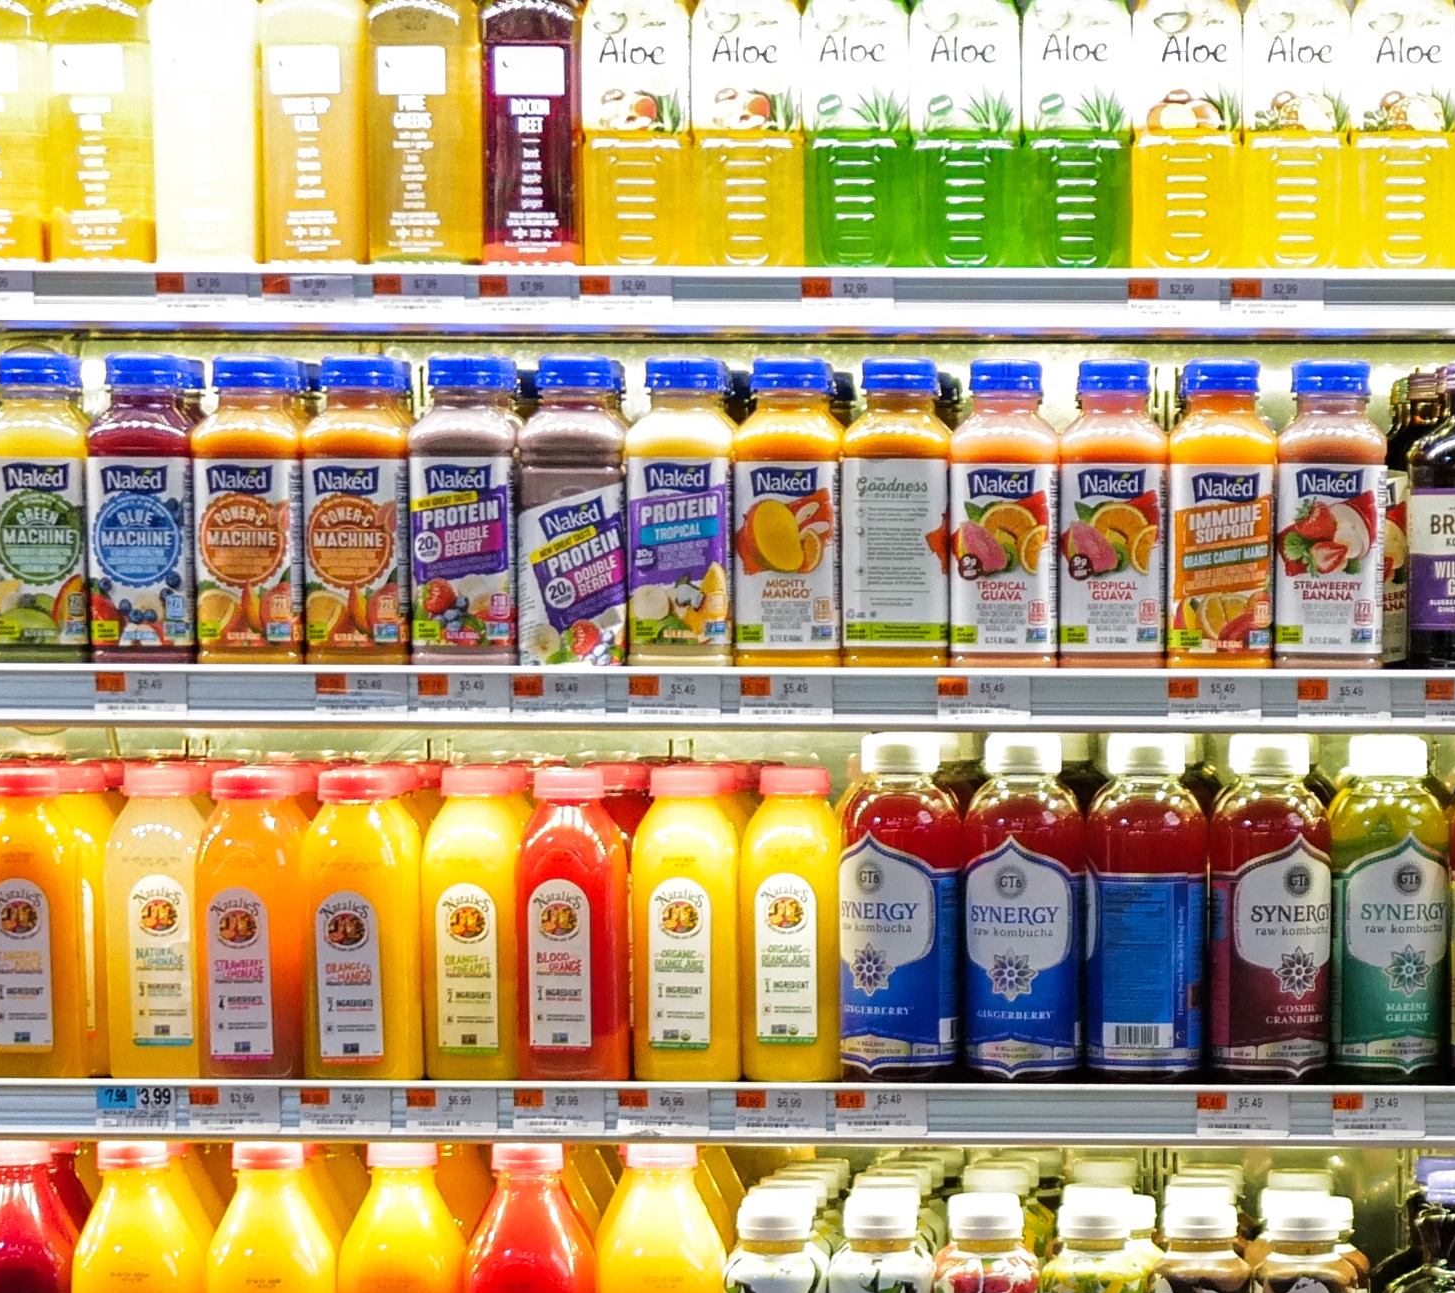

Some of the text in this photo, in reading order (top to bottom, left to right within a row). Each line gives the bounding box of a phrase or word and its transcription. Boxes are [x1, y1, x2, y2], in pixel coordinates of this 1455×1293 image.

[599, 36, 666, 67] Aloe
[819, 36, 886, 63] Aloe
[1161, 36, 1228, 64] Aloe
[106, 468, 163, 491] Naked
[856, 476, 928, 496] Goodness
[972, 472, 1031, 497] Naked
[119, 510, 153, 526] BLUE
[216, 508, 267, 527] POWER-C
[421, 500, 499, 524] PROTEIN
[642, 497, 718, 523] PROTEIN
[1188, 506, 1262, 529] IMMUNE
[546, 503, 602, 537] Naked
[102, 530, 173, 548] MACHINE
[207, 529, 278, 548] MACHINE
[444, 524, 490, 541] DOUBLE
[653, 523, 701, 539] TROPICAL
[1195, 522, 1256, 543] SUPPORT
[444, 539, 483, 556] BERRY
[762, 588, 809, 599] MANGO
[766, 579, 807, 589] MIGHTY
[976, 581, 1028, 591] TROPICAL
[1293, 581, 1361, 591] STRAWBERRY
[981, 590, 1023, 601] GUAVA
[1302, 590, 1354, 601] BANANA
[971, 905, 1058, 925] SYNERGY
[977, 1008, 1051, 1020] GINGERBERRY
